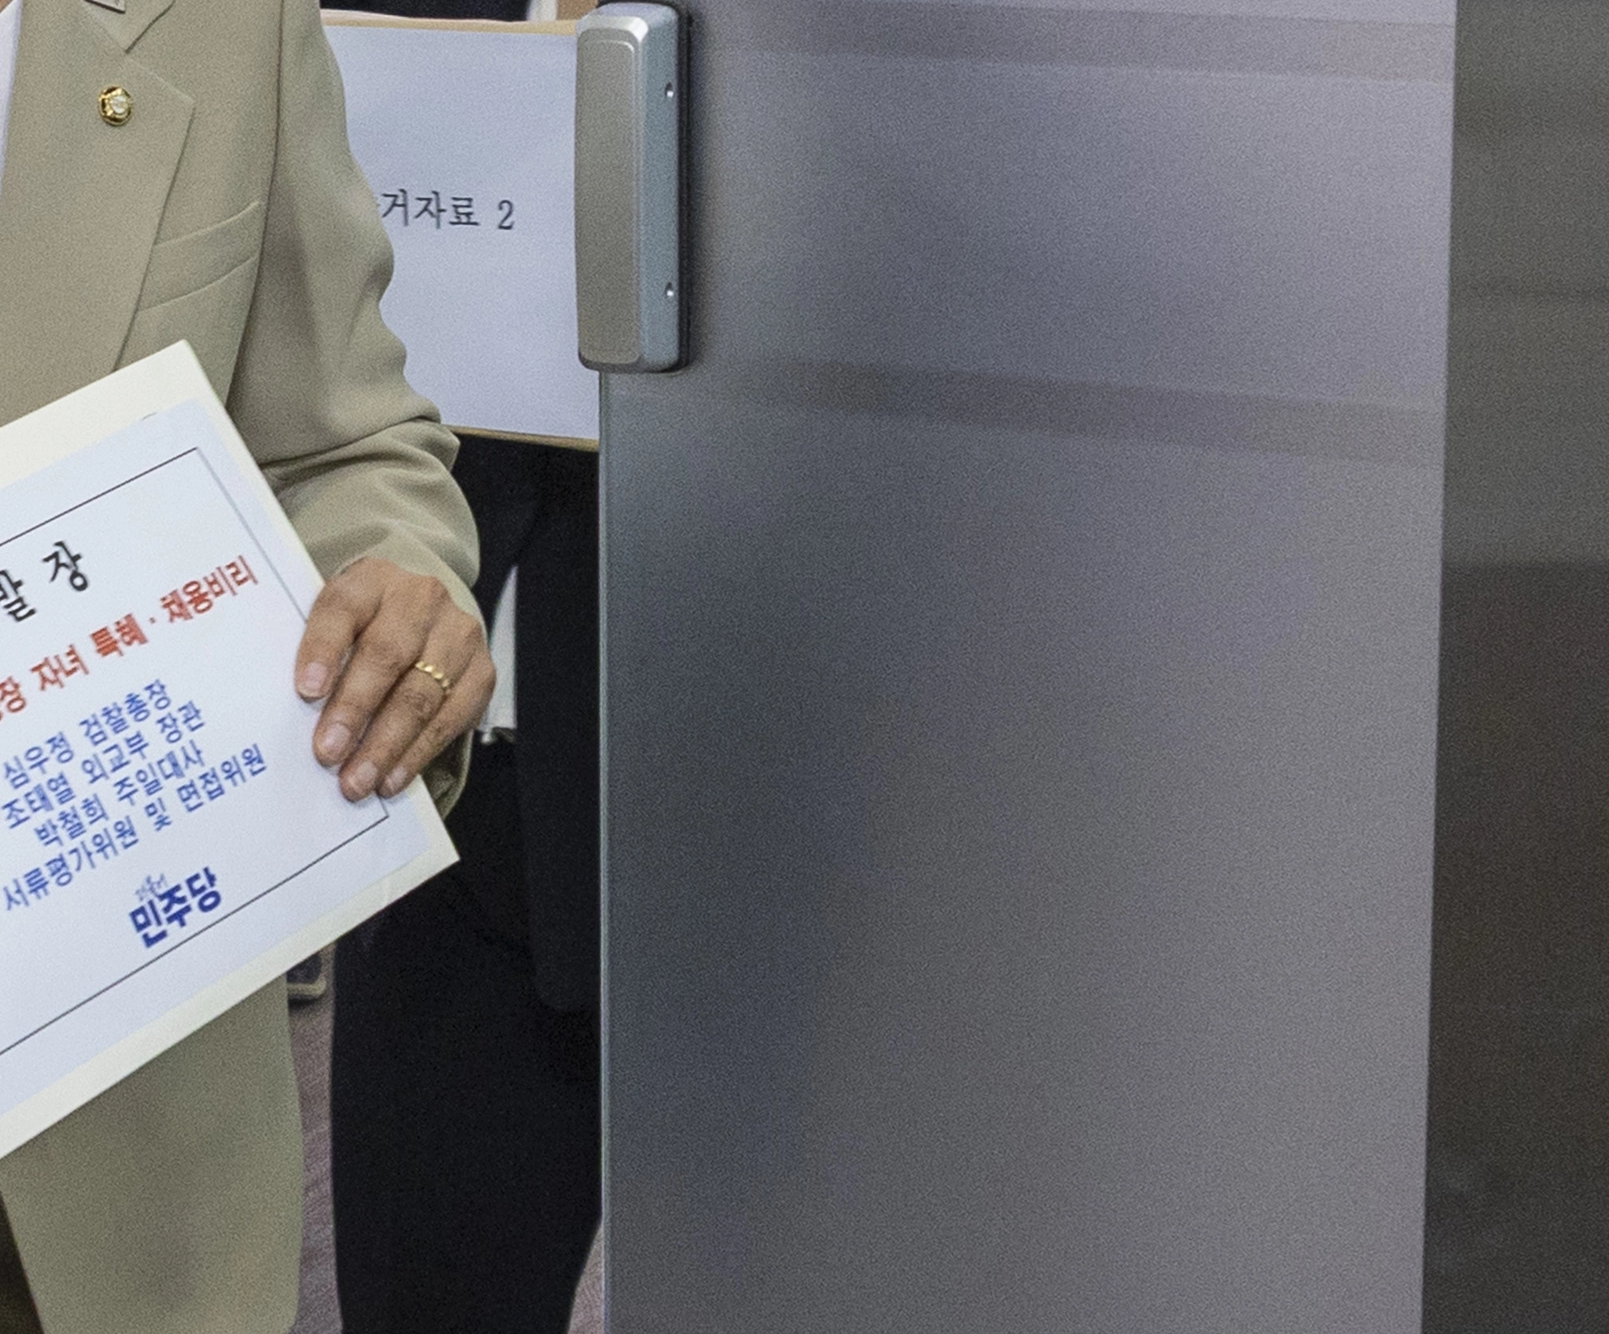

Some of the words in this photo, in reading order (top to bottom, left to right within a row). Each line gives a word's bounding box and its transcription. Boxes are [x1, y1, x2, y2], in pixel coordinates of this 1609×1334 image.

[376, 189, 480, 229] 거자료
[498, 200, 514, 230] 2
[30, 645, 88, 690] 자녀
[2, 773, 75, 828] 조태열
[83, 732, 148, 783] 외교부
[157, 702, 204, 743] 장관
[5, 732, 73, 789] 심우정
[80, 680, 170, 745] 검찰총장
[4, 816, 138, 910] 서류평가위원
[144, 797, 172, 832] 및
[177, 745, 266, 812] 면접위원
[35, 795, 108, 845] 박철희
[114, 740, 204, 805] 주일대사
[129, 867, 221, 948] 민주당
